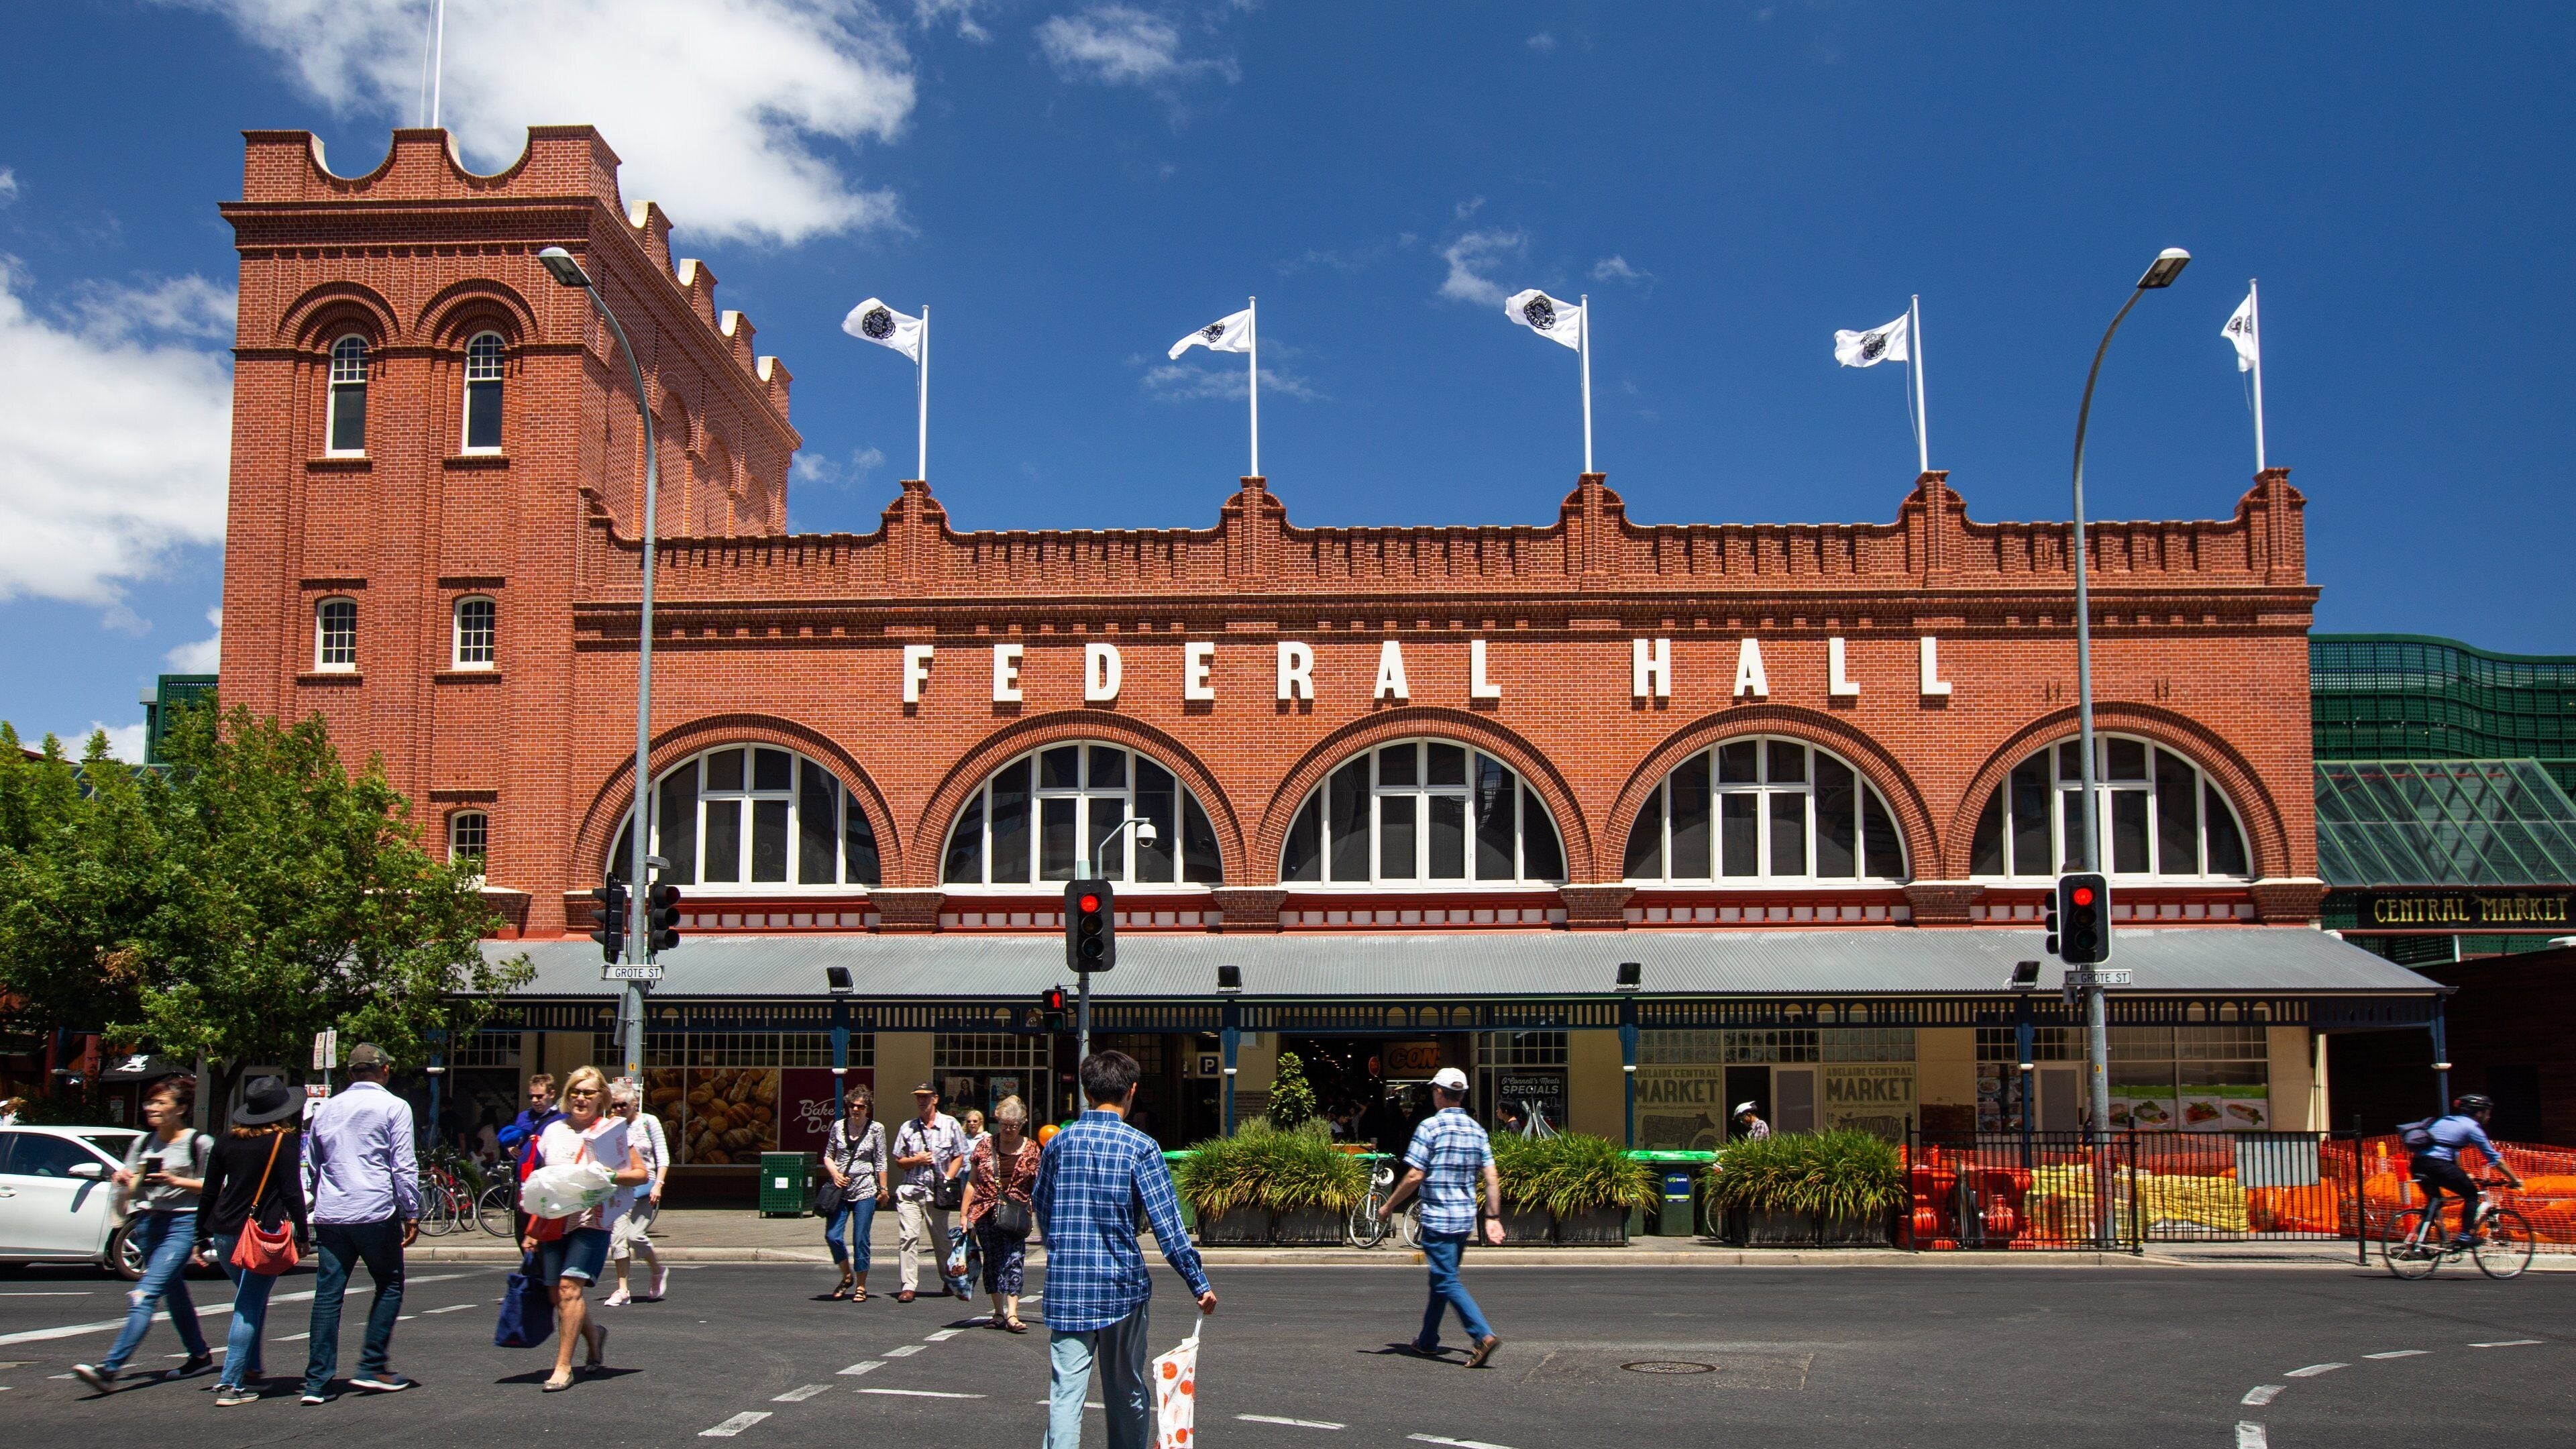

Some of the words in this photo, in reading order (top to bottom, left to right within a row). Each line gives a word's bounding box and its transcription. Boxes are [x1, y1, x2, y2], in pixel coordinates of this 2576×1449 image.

[904, 640, 1501, 702] FEDERAL
[1633, 637, 1951, 696] HALL
[2374, 898, 2470, 922] CENTRAL
[2480, 898, 2568, 921] MARKET
[615, 968, 643, 977] GROTE
[648, 968, 659, 977] ST
[2081, 973, 2110, 983] GROTE
[2116, 973, 2127, 982] ST
[1389, 1047, 1440, 1069] CON
[1205, 1059, 1215, 1072] P
[1674, 1069, 1718, 1077] CENTRAL
[1826, 1067, 1866, 1076] ADELAIDE
[1868, 1067, 1913, 1076] CENTRAL
[1540, 1077, 1560, 1085] Meats
[1502, 1085, 1559, 1094] SPECIALS
[1633, 1079, 1718, 1102] MARKET
[1826, 1077, 1912, 1101] MARKET
